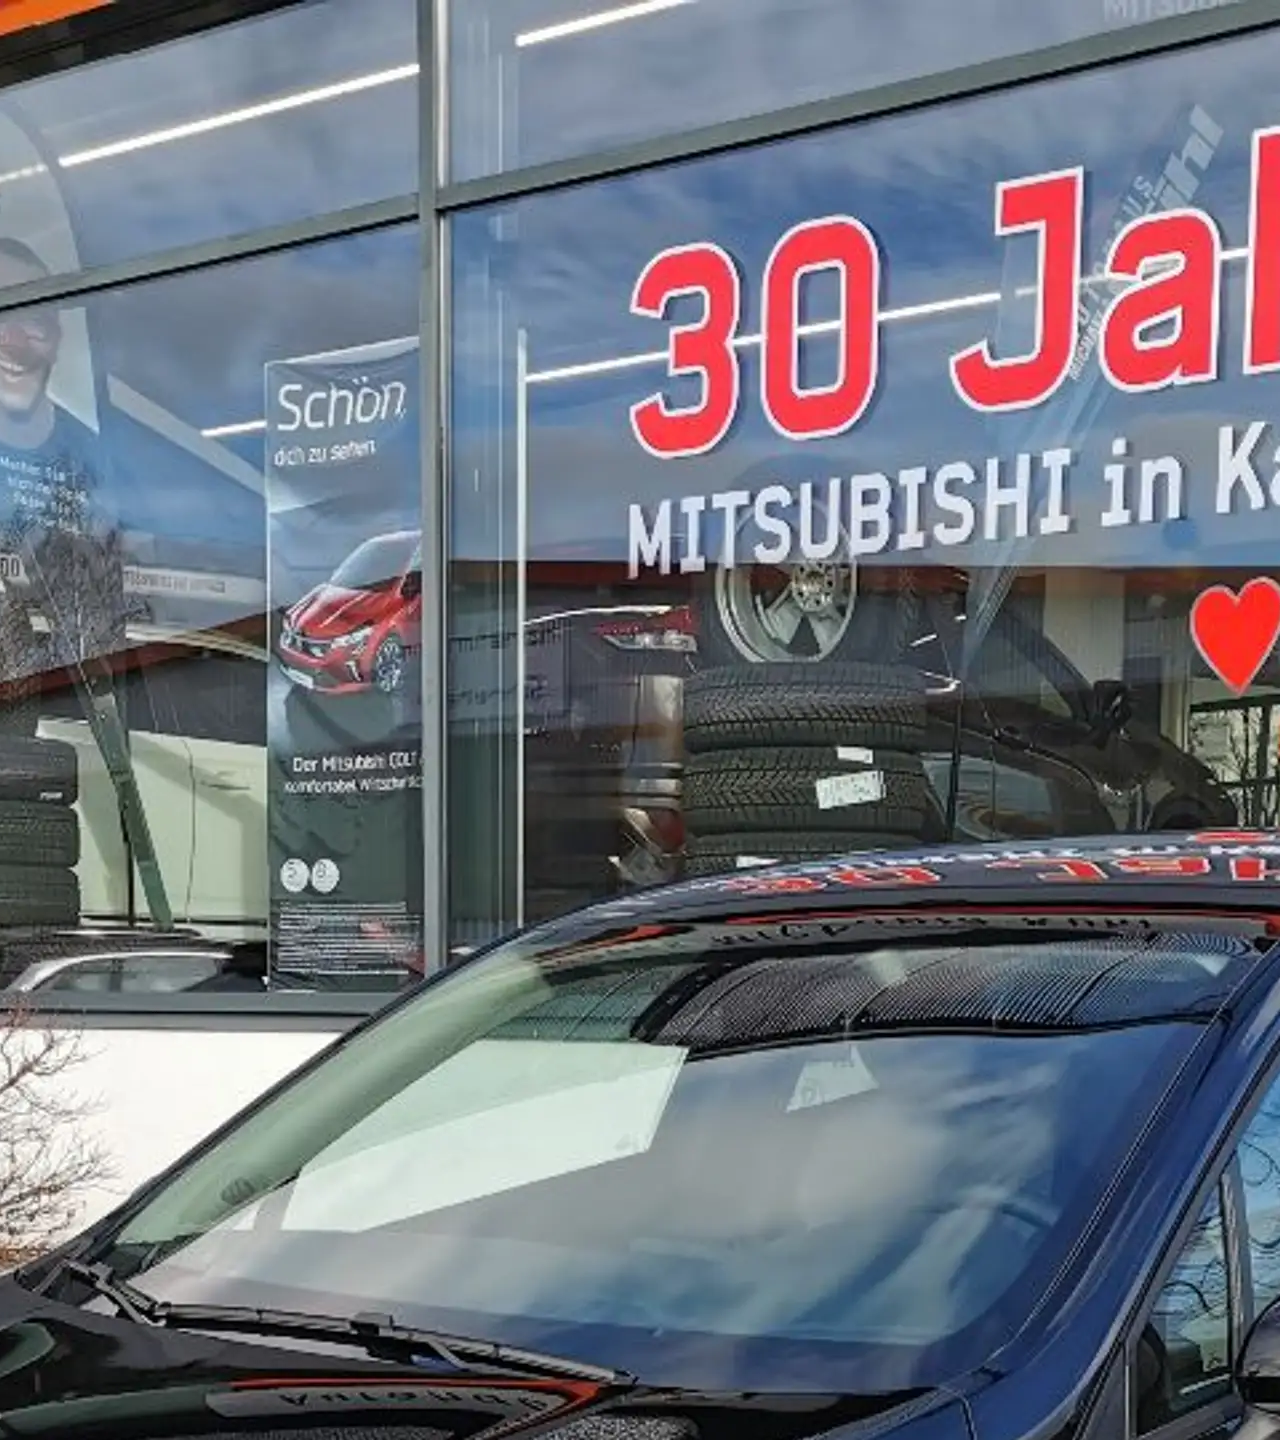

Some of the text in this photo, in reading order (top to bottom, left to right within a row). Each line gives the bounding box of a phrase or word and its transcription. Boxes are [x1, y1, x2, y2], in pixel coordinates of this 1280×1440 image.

[630, 215, 880, 460] 30
[308, 447, 327, 463] zu
[627, 448, 1071, 581] MITSUBISHI
[1100, 437, 1186, 528] in
[293, 756, 318, 773] Der
